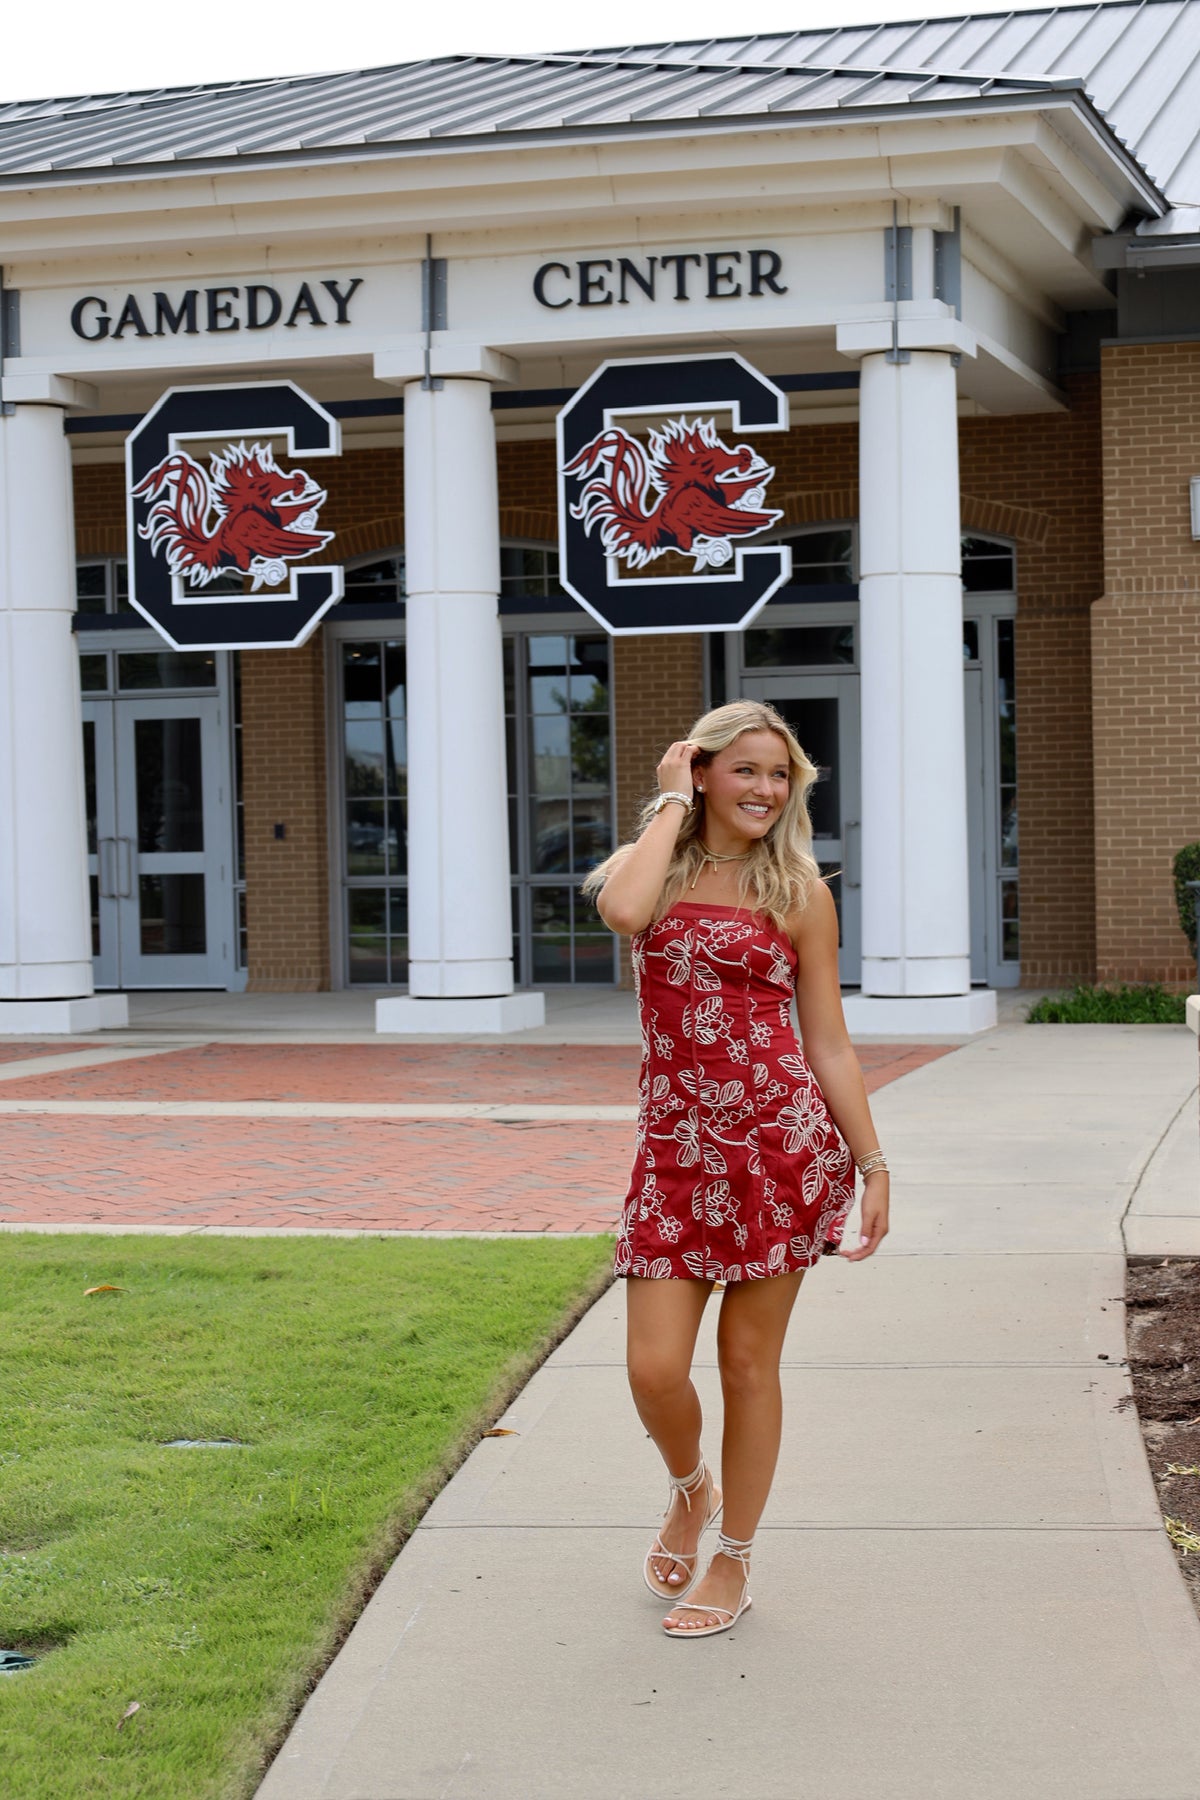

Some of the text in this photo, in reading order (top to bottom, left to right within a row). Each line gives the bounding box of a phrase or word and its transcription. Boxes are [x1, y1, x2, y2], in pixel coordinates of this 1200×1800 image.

[70, 249, 789, 341] GAMEDAY CENTER
[125, 379, 344, 651] C
[556, 351, 792, 636] C
